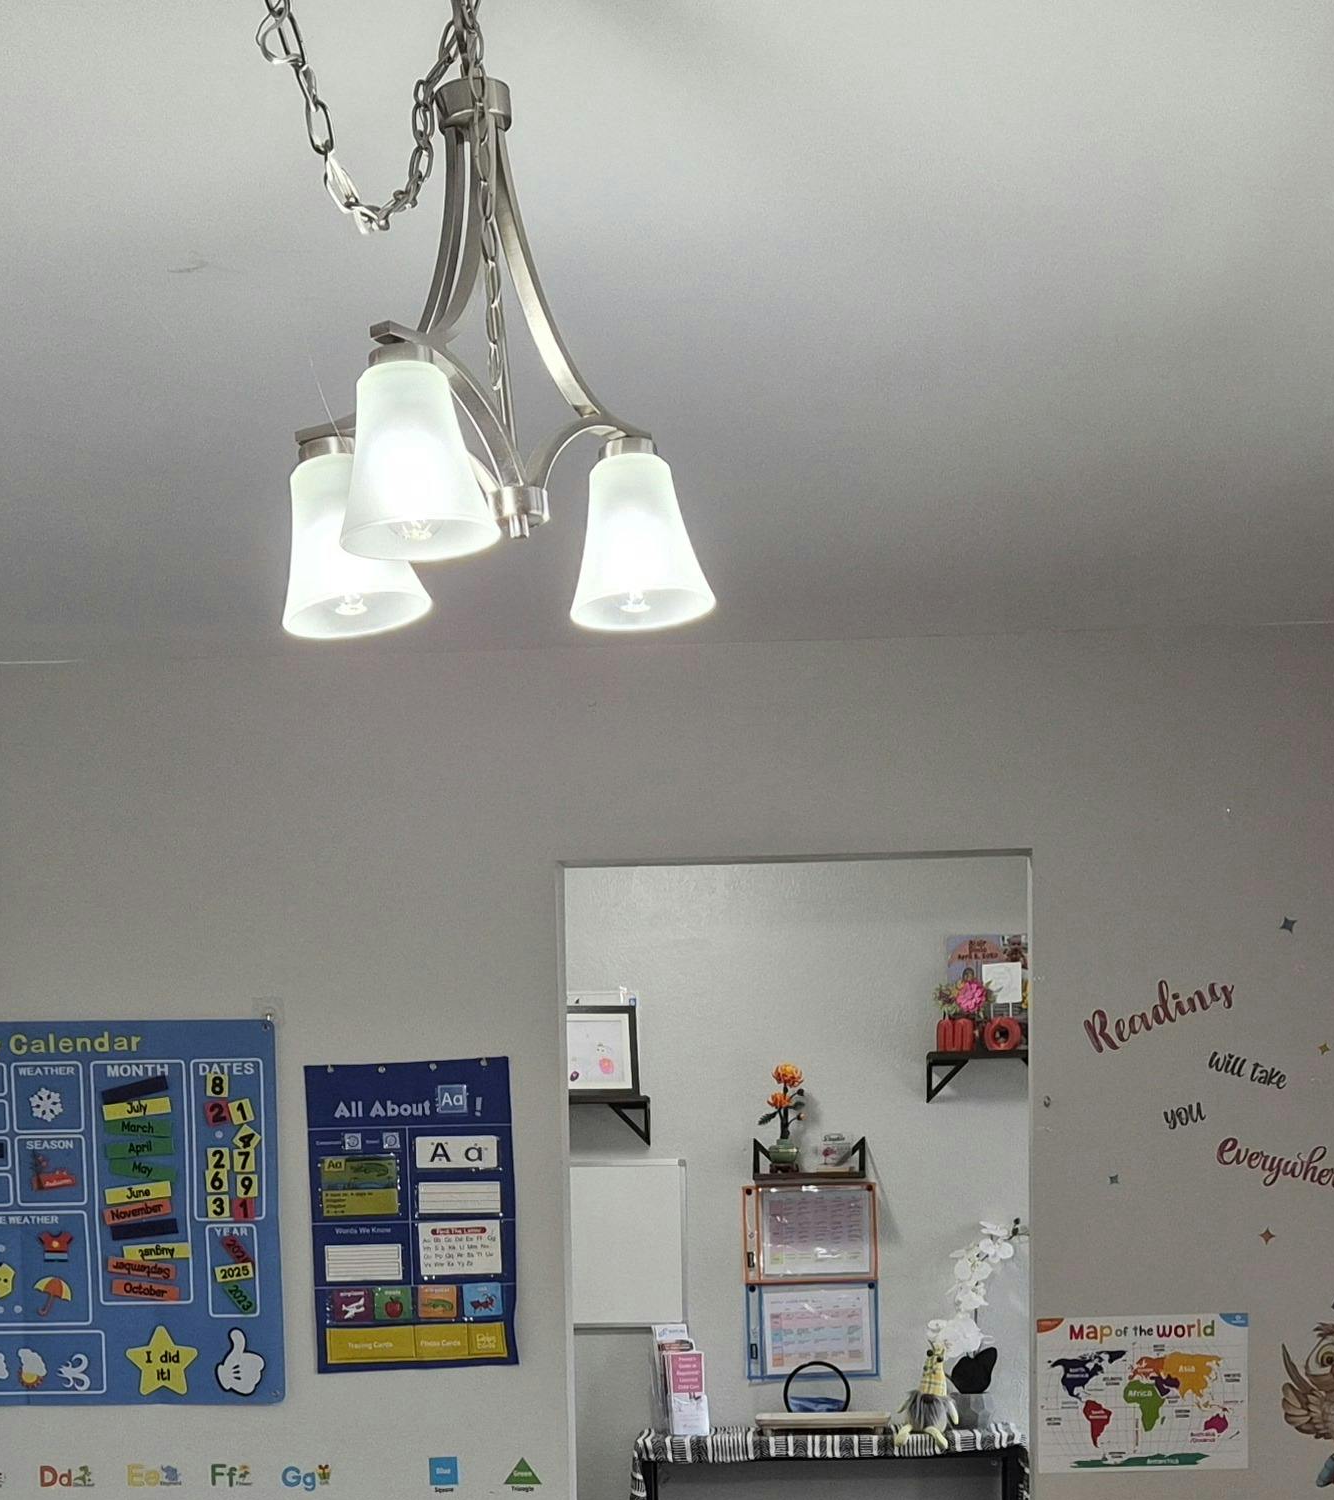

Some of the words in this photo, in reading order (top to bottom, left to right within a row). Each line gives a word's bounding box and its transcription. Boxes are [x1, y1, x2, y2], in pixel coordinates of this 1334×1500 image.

[1083, 979, 1234, 1054] Reading
[9, 1031, 141, 1056] Calendar
[18, 1065, 76, 1077] WEATHER
[106, 1063, 169, 1078] MONTH
[198, 1062, 256, 1077] DATES
[1208, 1051, 1247, 1078] will
[1250, 1062, 1288, 1090] take
[210, 1076, 225, 1096] 8
[126, 1101, 149, 1116] July
[208, 1102, 227, 1124] 2
[236, 1101, 248, 1122] 1
[334, 1100, 364, 1119] All
[370, 1098, 431, 1118] About
[441, 1090, 464, 1106] Aa
[1163, 1102, 1207, 1130] you
[121, 1121, 155, 1134] March
[26, 1139, 75, 1151] SEASON
[127, 1141, 153, 1156] April
[429, 1142, 451, 1164] A
[464, 1145, 485, 1163] a
[211, 1149, 226, 1170] 2
[237, 1151, 251, 1171] 7
[131, 1161, 154, 1178] May
[209, 1170, 224, 1191] 6
[239, 1175, 254, 1196] 9
[126, 1187, 152, 1200] June
[110, 1202, 164, 1221] November
[212, 1196, 226, 1217] 3
[238, 1199, 250, 1219] 1
[3, 1213, 59, 1225] WEATHER
[214, 1227, 249, 1238] YEAR
[138, 1244, 176, 1262] August
[112, 1261, 172, 1281] September
[219, 1265, 251, 1280] 2025
[123, 1281, 168, 1299] October
[227, 1283, 253, 1313] 2023
[1069, 1323, 1113, 1344] Map
[1115, 1325, 1130, 1338] of
[1133, 1325, 1154, 1337] the
[1156, 1319, 1216, 1340] world
[145, 1351, 153, 1364] I
[160, 1350, 181, 1364] did
[1178, 1364, 1196, 1373] Asia
[1127, 1389, 1153, 1398] Africa
